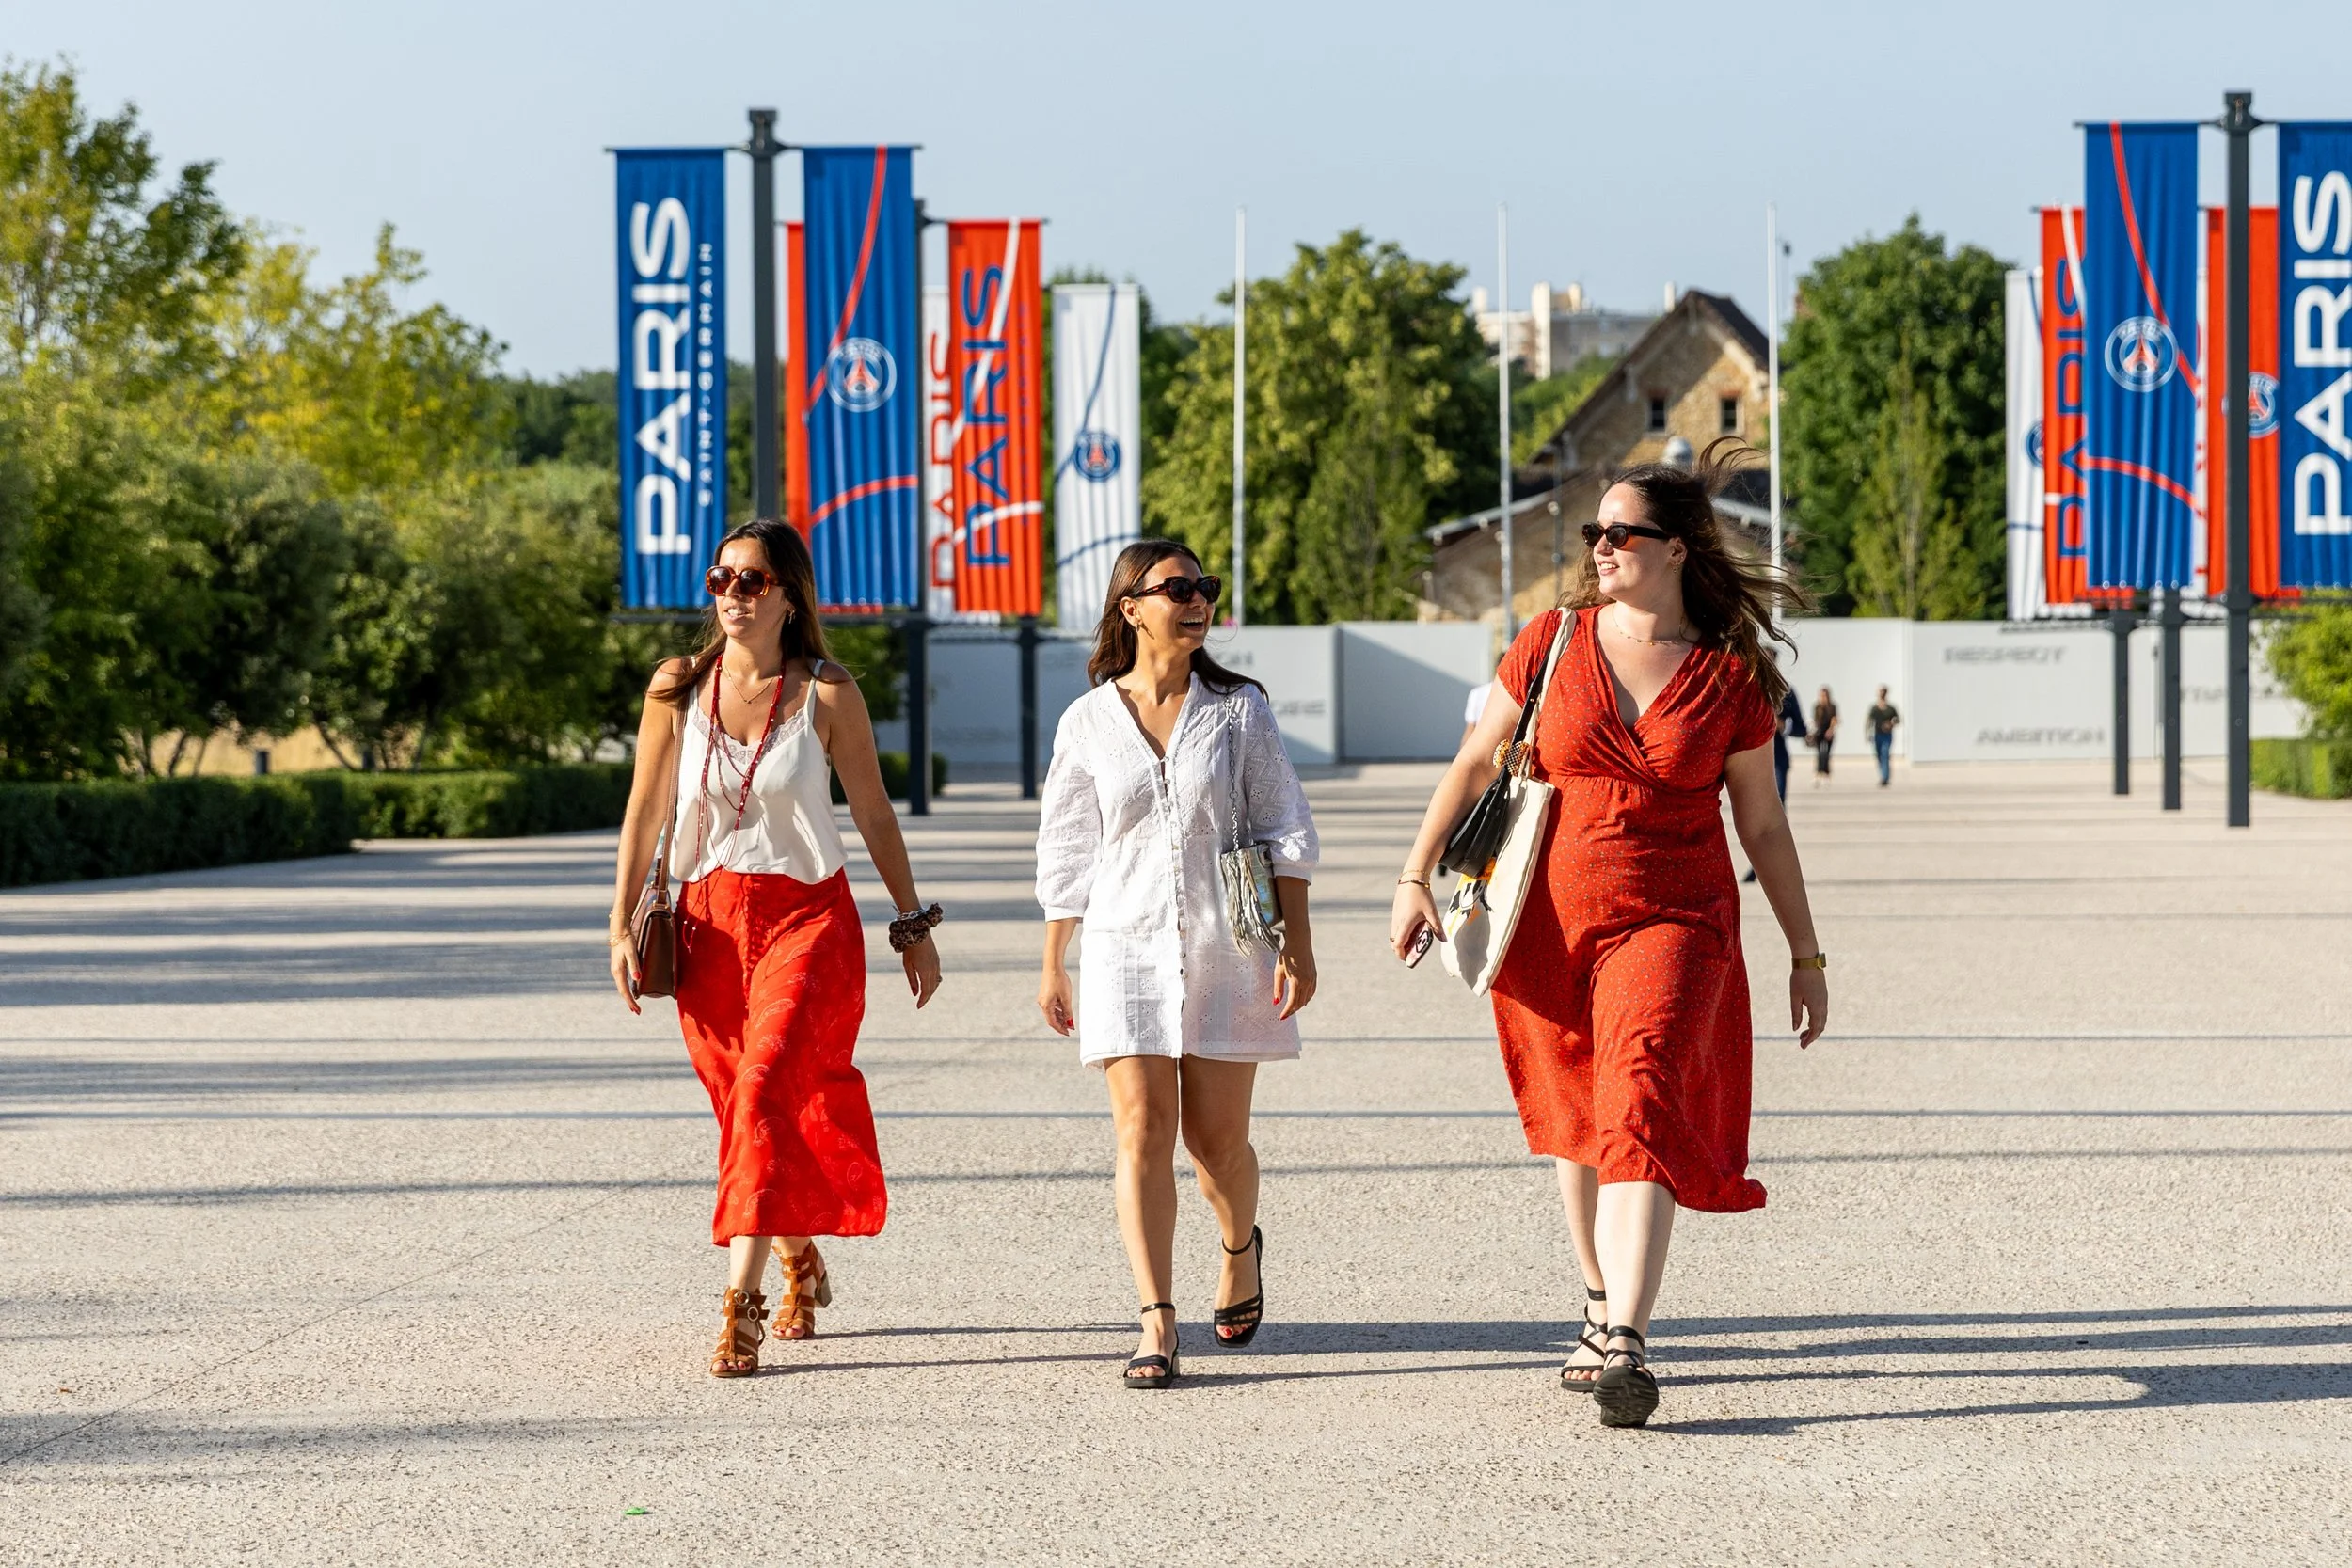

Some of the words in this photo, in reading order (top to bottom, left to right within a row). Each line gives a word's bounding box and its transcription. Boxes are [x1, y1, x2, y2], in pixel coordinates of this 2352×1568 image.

[629, 197, 691, 556] PARIS
[697, 242, 714, 509] SAINT-GERMAIN
[961, 264, 1009, 568] PARIS
[2293, 170, 2352, 536] PARIS
[1976, 726, 2106, 747] AMBITION
